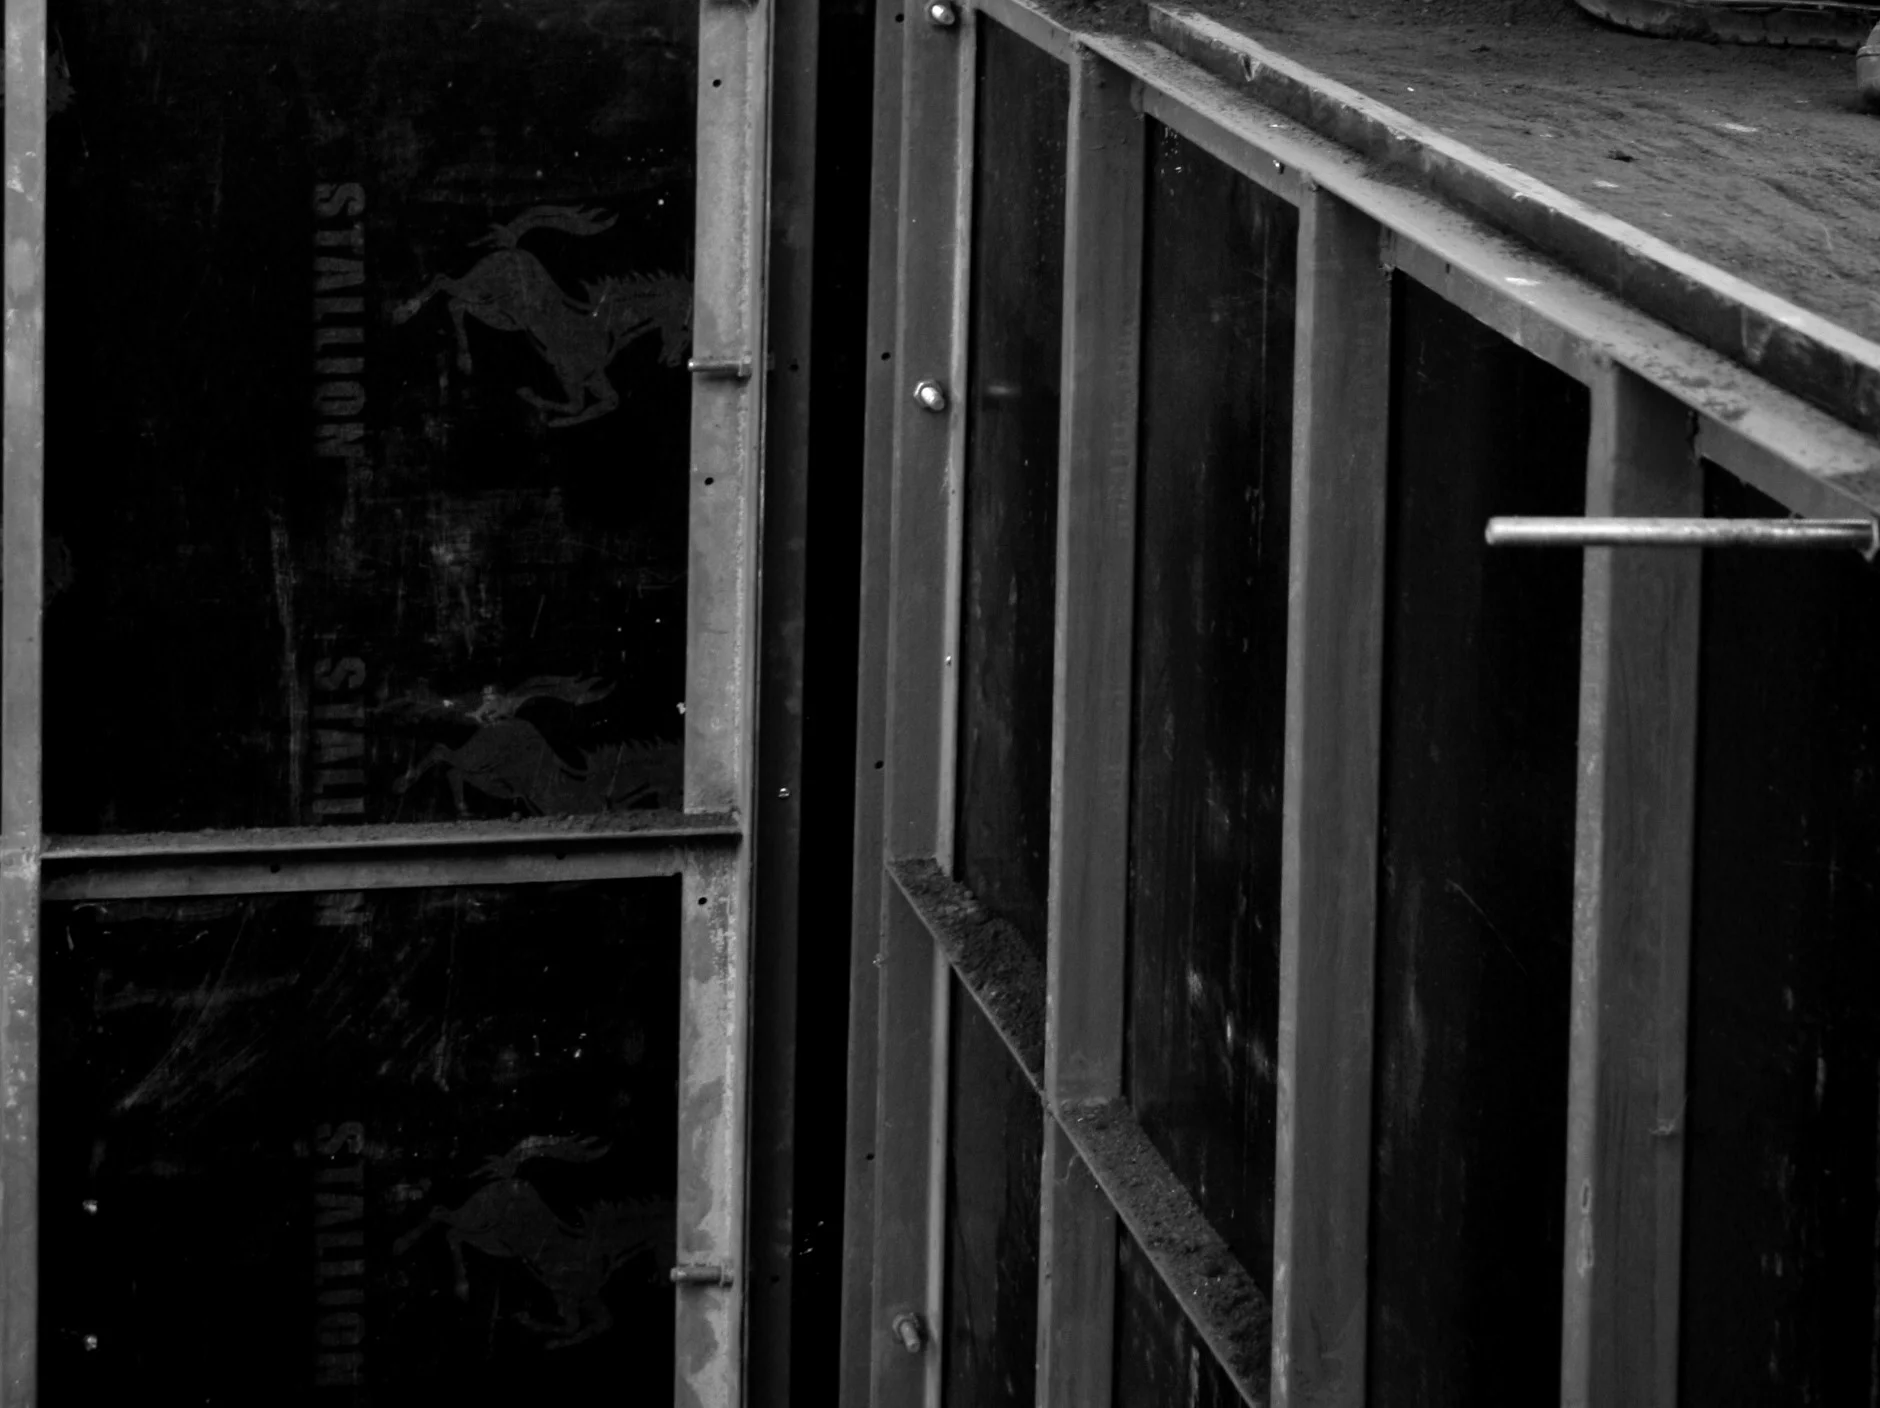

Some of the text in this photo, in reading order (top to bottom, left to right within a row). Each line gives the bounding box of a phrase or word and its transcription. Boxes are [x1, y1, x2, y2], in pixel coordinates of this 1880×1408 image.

[313, 182, 366, 459] STALLION
[313, 656, 366, 927] STALLN
[313, 1120, 366, 1388] STALLION
